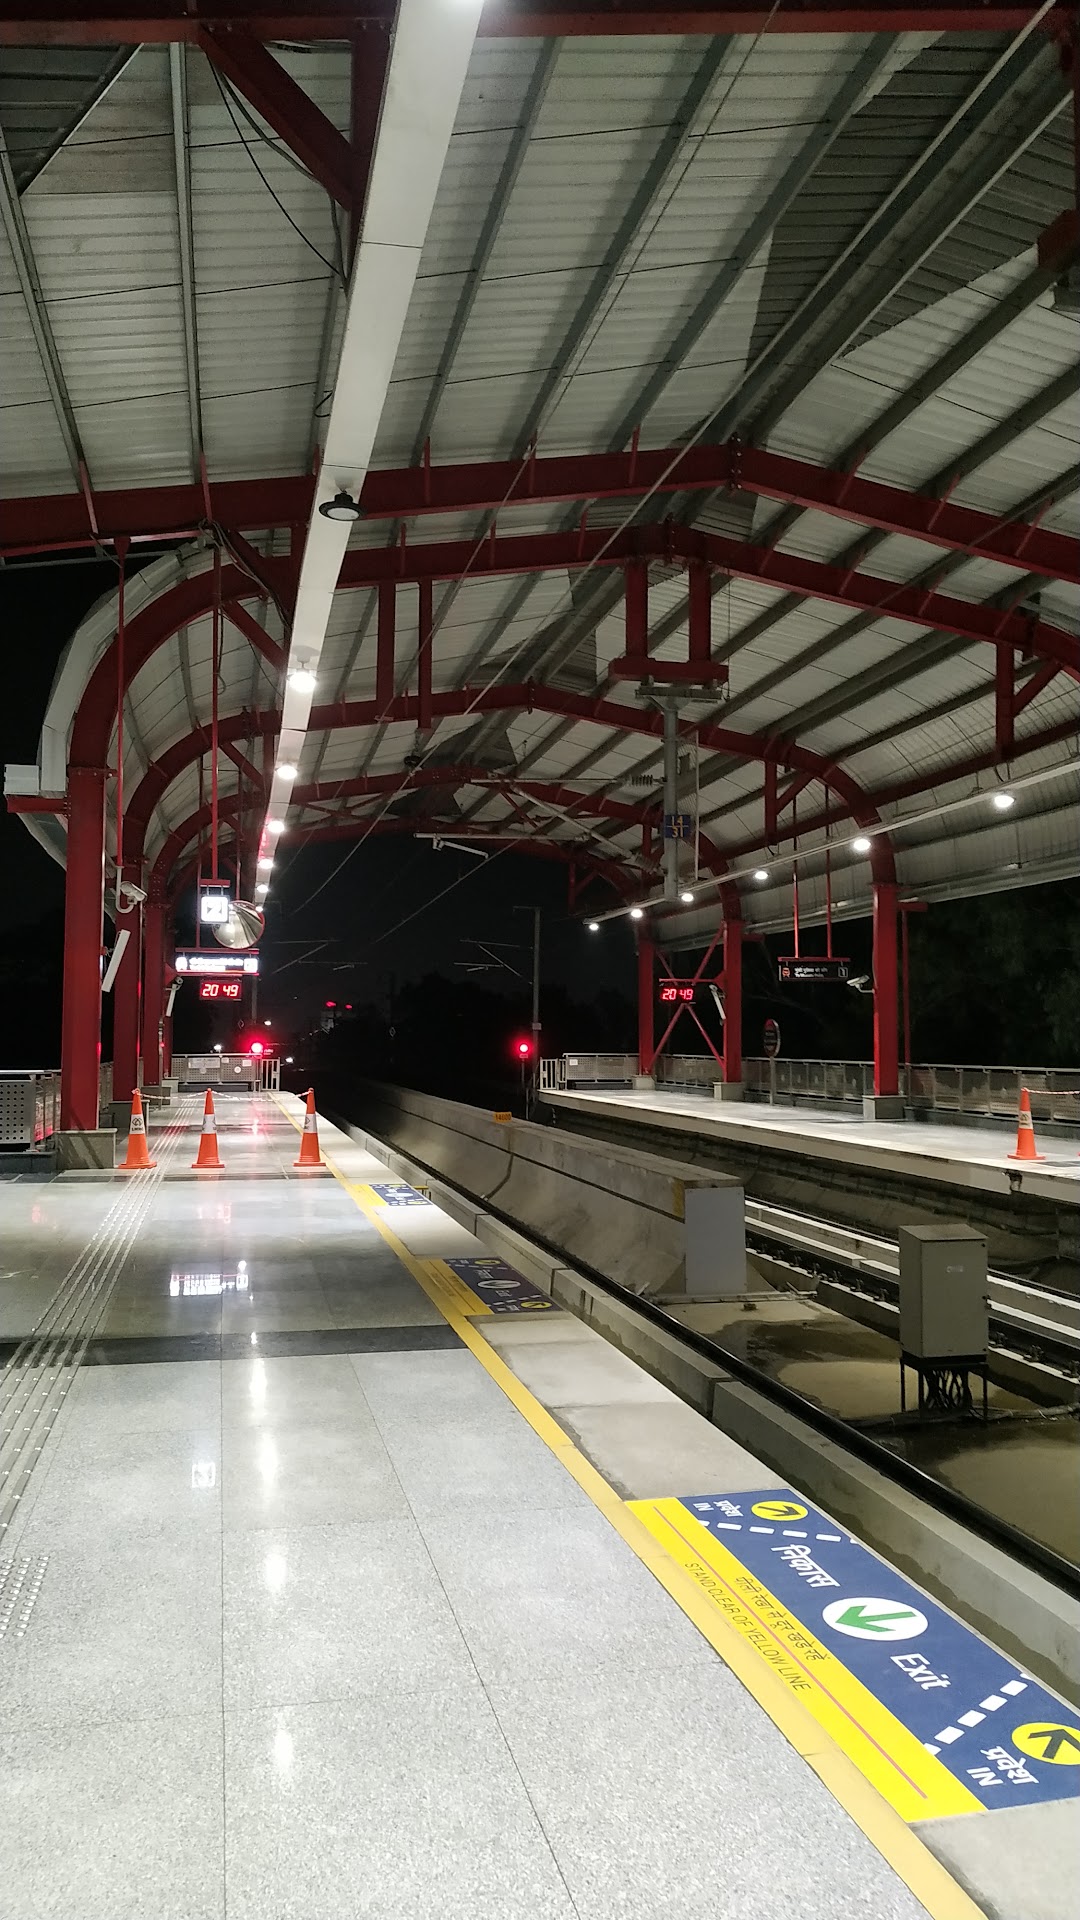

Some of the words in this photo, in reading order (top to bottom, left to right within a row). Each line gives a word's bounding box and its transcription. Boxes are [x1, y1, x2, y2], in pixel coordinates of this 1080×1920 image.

[202, 984, 220, 997] 20
[222, 984, 239, 997] 49
[662, 988, 677, 1001] 20
[679, 988, 694, 1001] 49
[692, 1502, 715, 1512] IN
[713, 1500, 744, 1517] प्रवेश
[770, 1544, 841, 1588] निकास
[685, 1563, 716, 1588] STAND
[707, 1588, 741, 1614] CLEAR
[732, 1615, 754, 1627] OF
[744, 1628, 789, 1665] YELLOW
[778, 1667, 812, 1691] LINE
[890, 1653, 952, 1691] Exit
[980, 1745, 1040, 1785] प्रवेश
[966, 1767, 1004, 1787] IN
